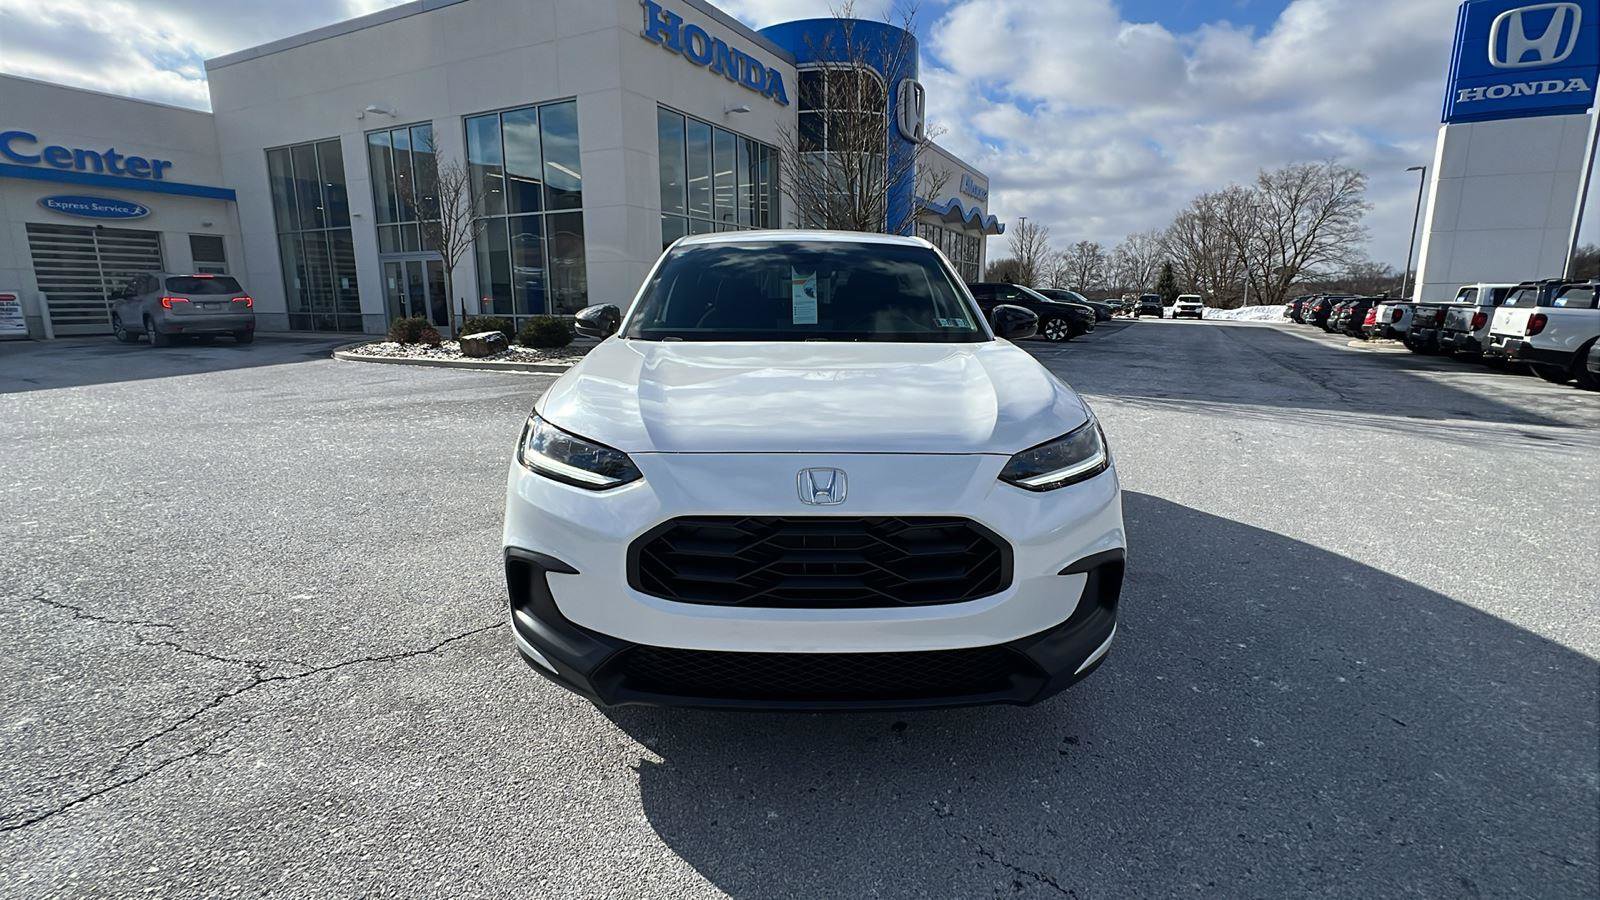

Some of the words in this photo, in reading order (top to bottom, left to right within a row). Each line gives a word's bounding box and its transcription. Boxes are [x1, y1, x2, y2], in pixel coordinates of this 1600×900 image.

[641, 0, 789, 105] HONDA
[1457, 78, 1591, 103] HONDA
[0, 130, 172, 179] Center
[47, 199, 90, 210] Express
[91, 203, 129, 213] Service
